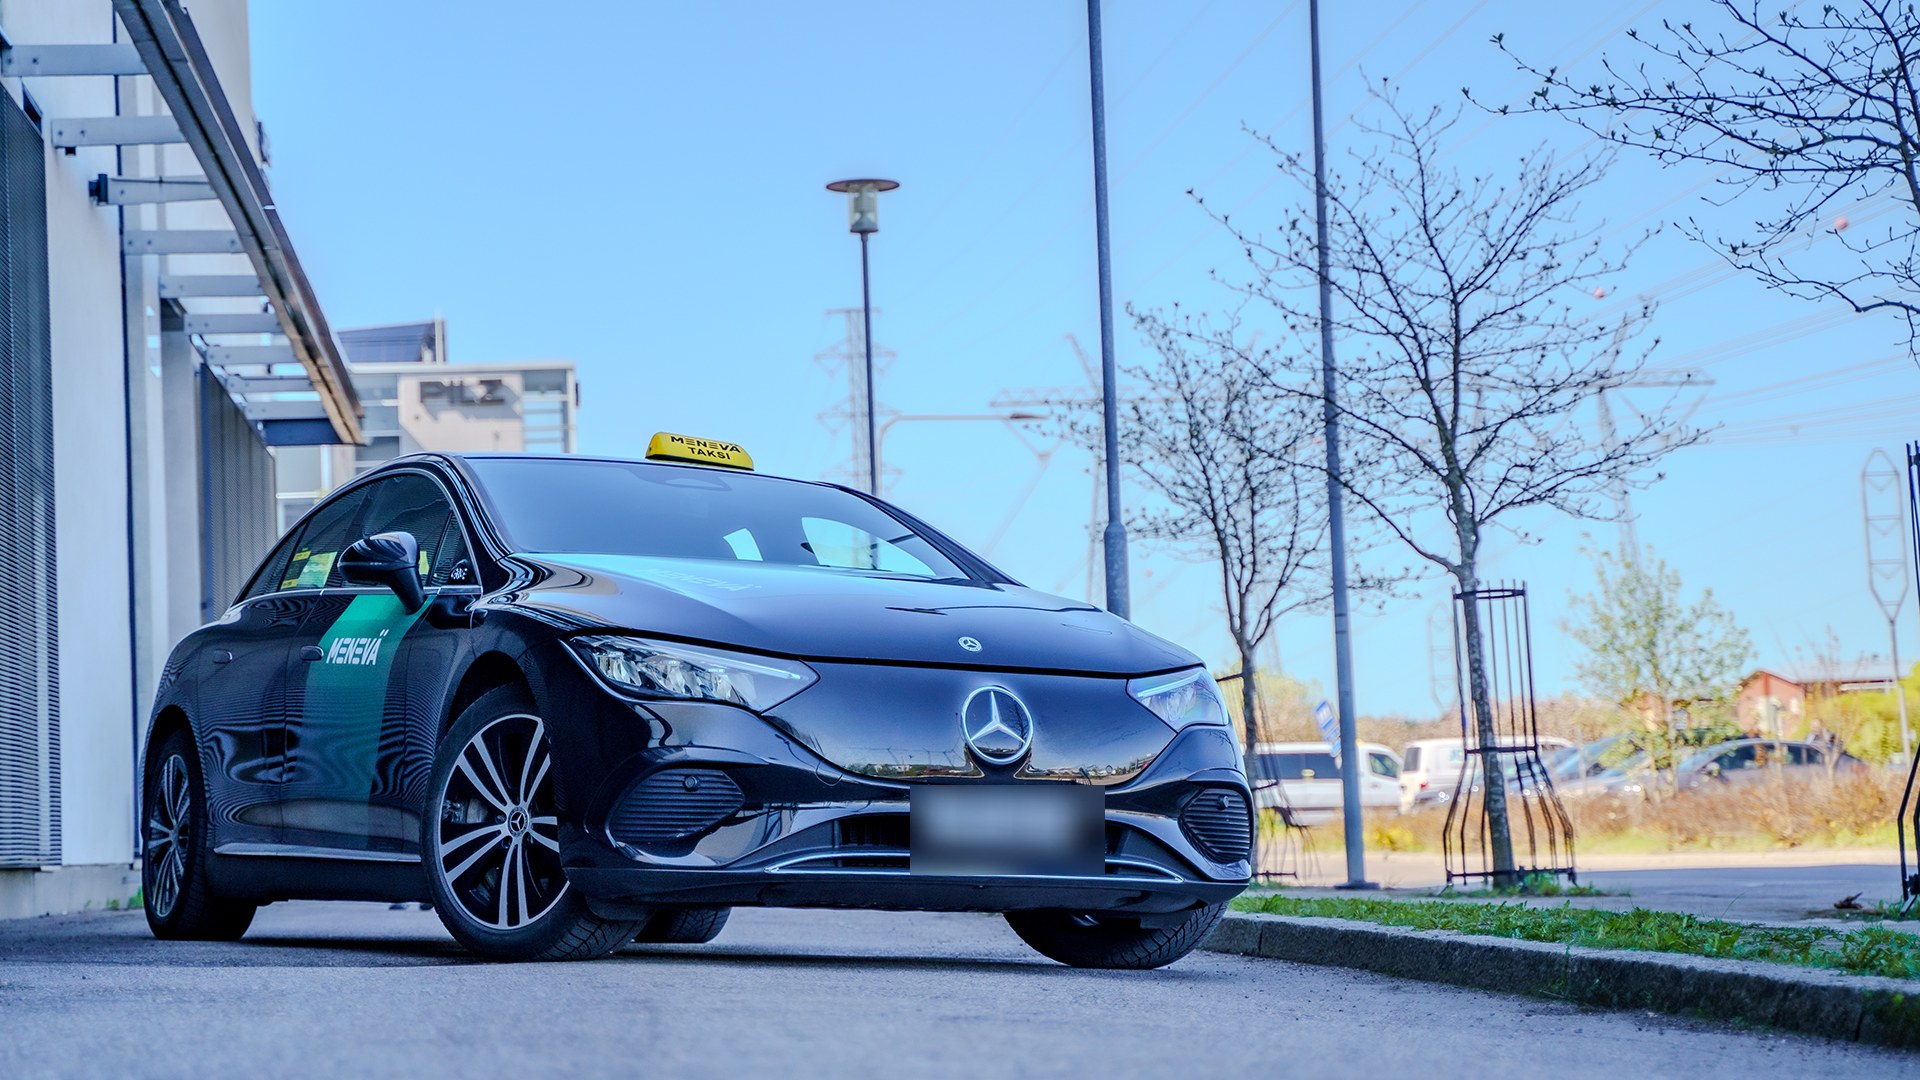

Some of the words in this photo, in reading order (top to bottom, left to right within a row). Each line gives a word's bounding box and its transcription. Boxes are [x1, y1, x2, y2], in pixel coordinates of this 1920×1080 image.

[419, 379, 505, 405] PILZ
[688, 446, 731, 460] TAKSI
[326, 629, 389, 666] MENEVÄ
